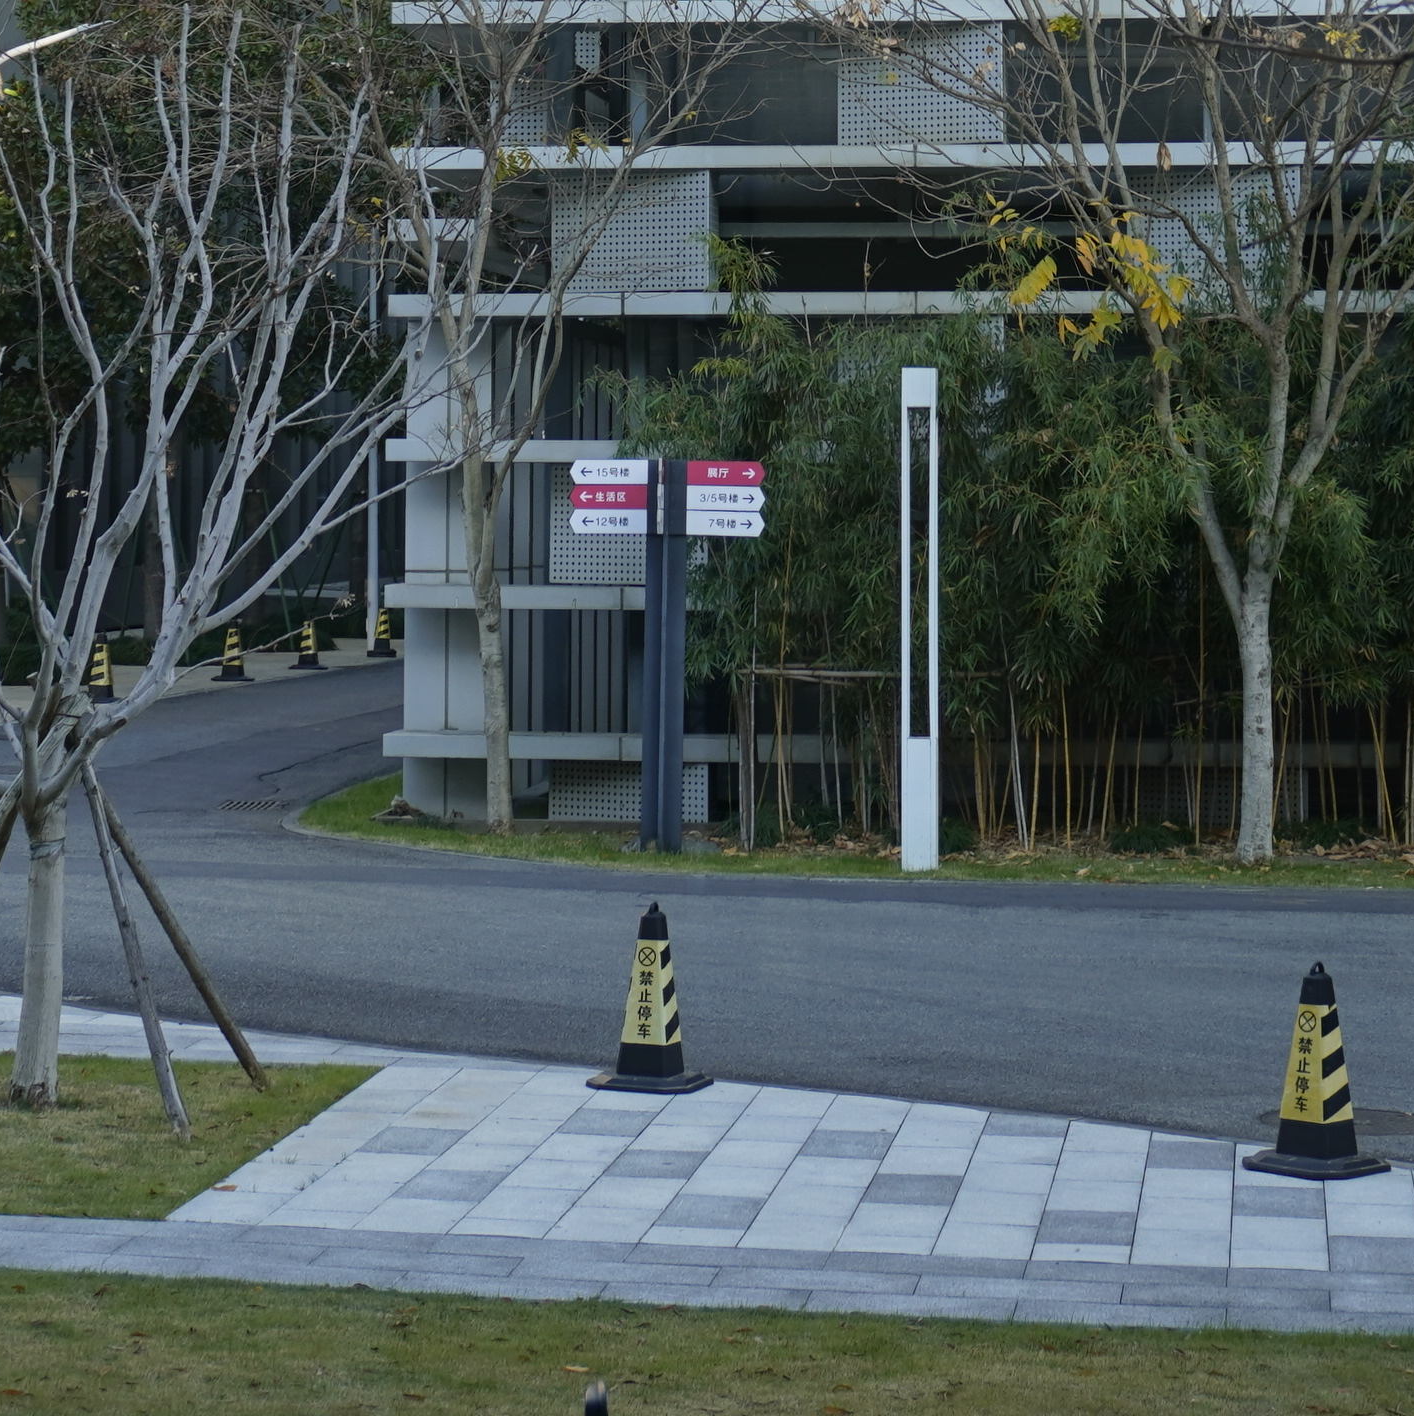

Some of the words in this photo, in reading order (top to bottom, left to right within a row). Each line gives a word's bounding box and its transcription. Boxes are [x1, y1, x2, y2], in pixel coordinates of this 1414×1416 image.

[596, 467, 630, 477] 15号楼
[707, 468, 729, 478] 展厅
[595, 491, 626, 502] 生活区
[699, 494, 739, 504] 3/5号楼
[596, 516, 629, 527] 12号楼
[708, 519, 737, 529] 7号楼
[637, 970, 654, 1039] 禁止停车
[1294, 1037, 1313, 1113] 禁止停车
